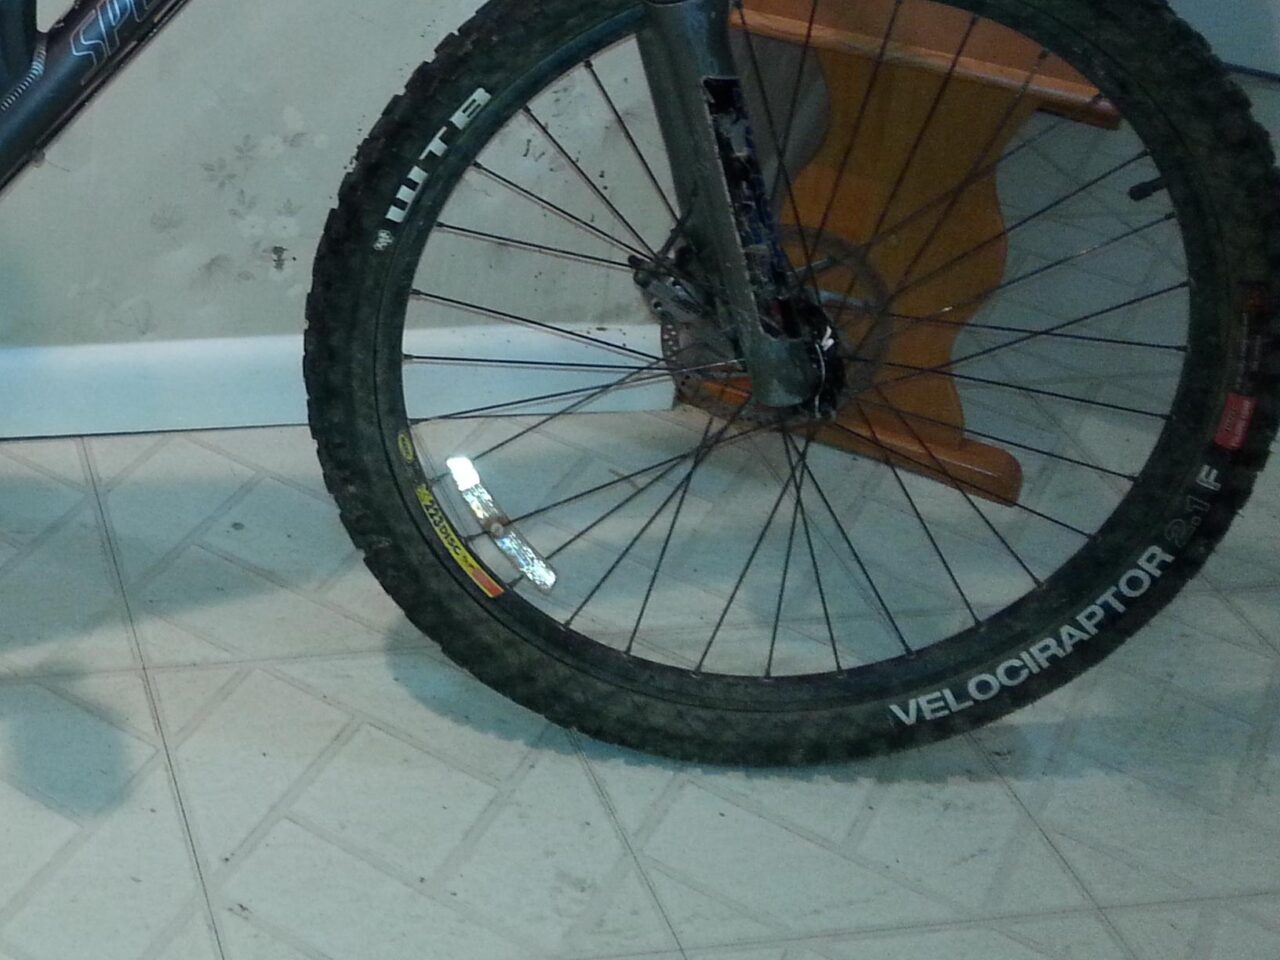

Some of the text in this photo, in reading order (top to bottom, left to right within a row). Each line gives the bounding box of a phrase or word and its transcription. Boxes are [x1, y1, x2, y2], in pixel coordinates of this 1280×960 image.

[385, 87, 492, 223] WTB
[889, 544, 1176, 727] VELOCIRAPTOR
[1196, 464, 1222, 491] F
